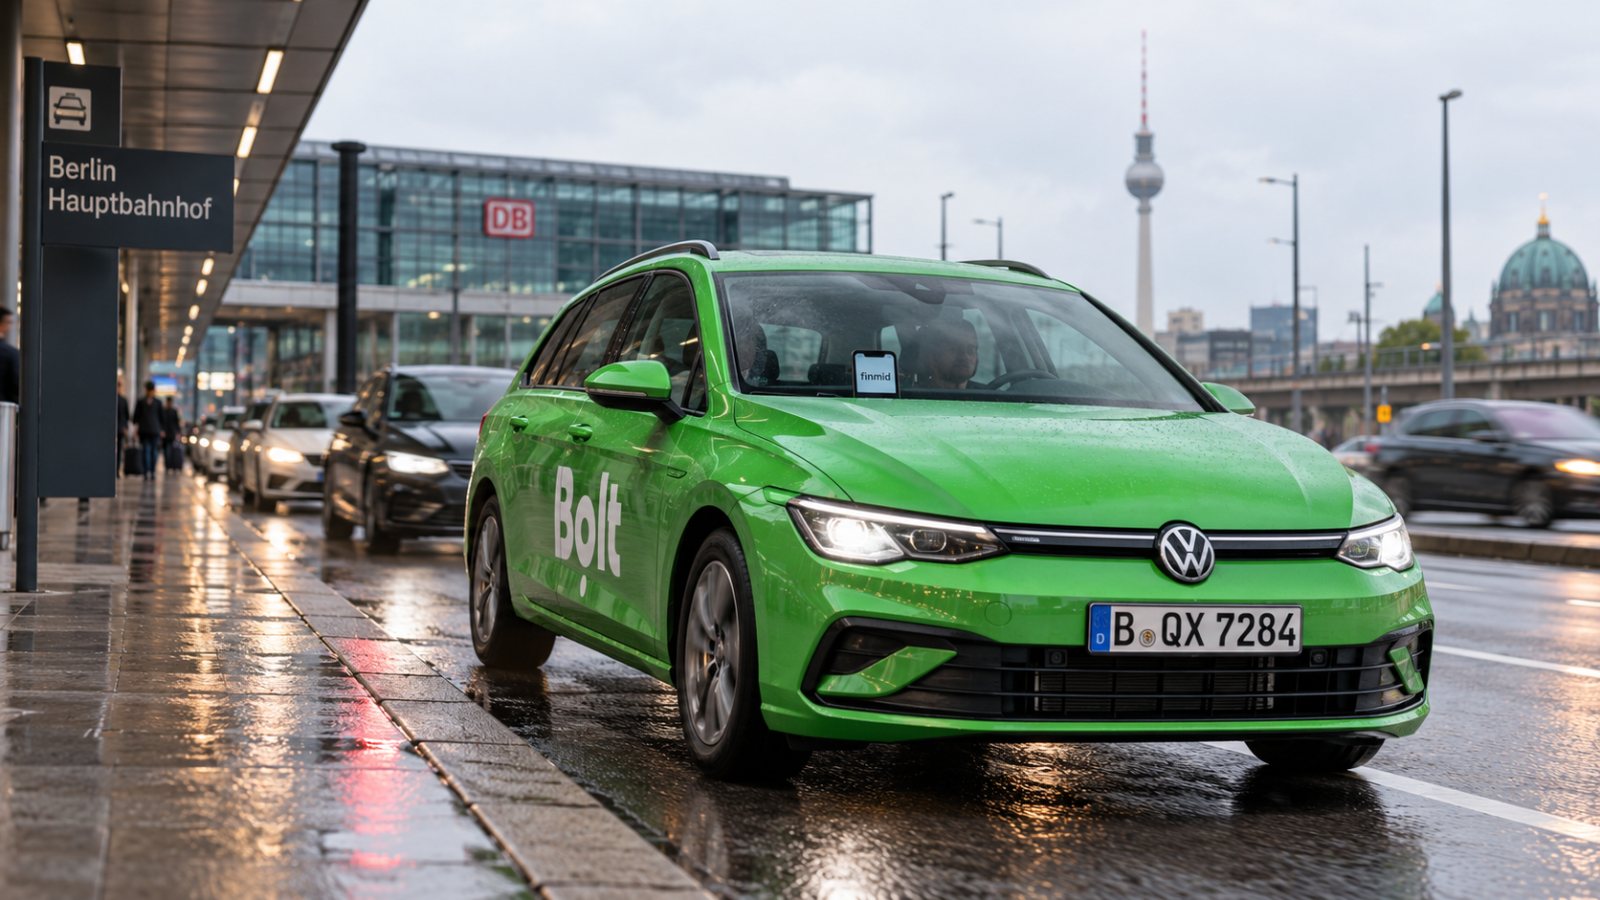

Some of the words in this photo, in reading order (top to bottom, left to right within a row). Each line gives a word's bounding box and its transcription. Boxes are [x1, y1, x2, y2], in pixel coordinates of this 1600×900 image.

[49, 155, 117, 182] Berlin
[48, 187, 213, 220] Hauptbahnhof
[493, 207, 528, 230] DB
[860, 371, 891, 381] finmid
[554, 465, 622, 578] Bolt
[1161, 527, 1214, 580] VW
[1096, 633, 1105, 645] D
[1114, 611, 1135, 646] B
[1161, 611, 1205, 648] QX
[1216, 612, 1296, 647] 7284
